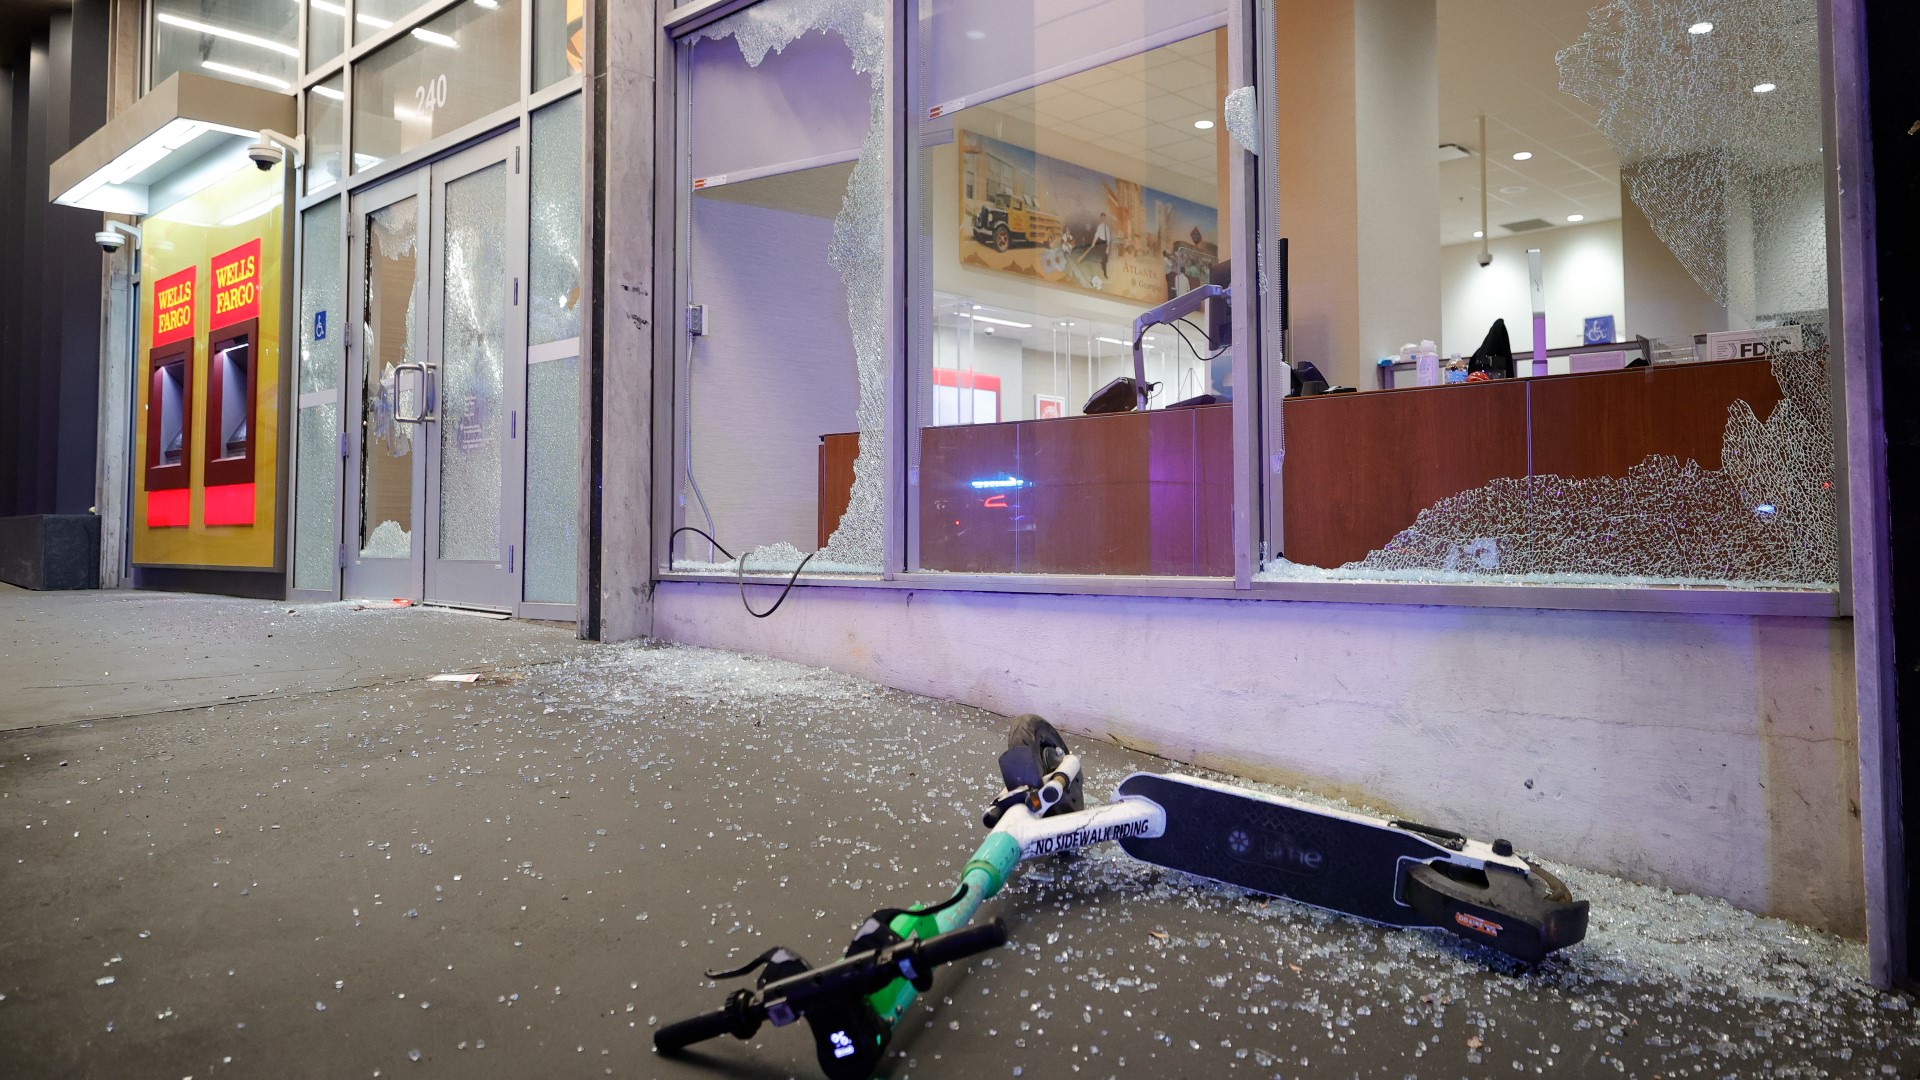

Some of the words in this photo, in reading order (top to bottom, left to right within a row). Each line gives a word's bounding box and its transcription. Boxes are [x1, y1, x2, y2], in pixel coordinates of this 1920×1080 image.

[415, 74, 447, 117] 240
[216, 255, 255, 289] WELLS
[158, 281, 192, 310] WELLS
[216, 282, 254, 314] FARGO
[158, 305, 191, 334] FARGO
[1035, 839, 1053, 855] NO
[1055, 826, 1111, 850] SIDEWALK
[1113, 819, 1149, 837] RIDING
